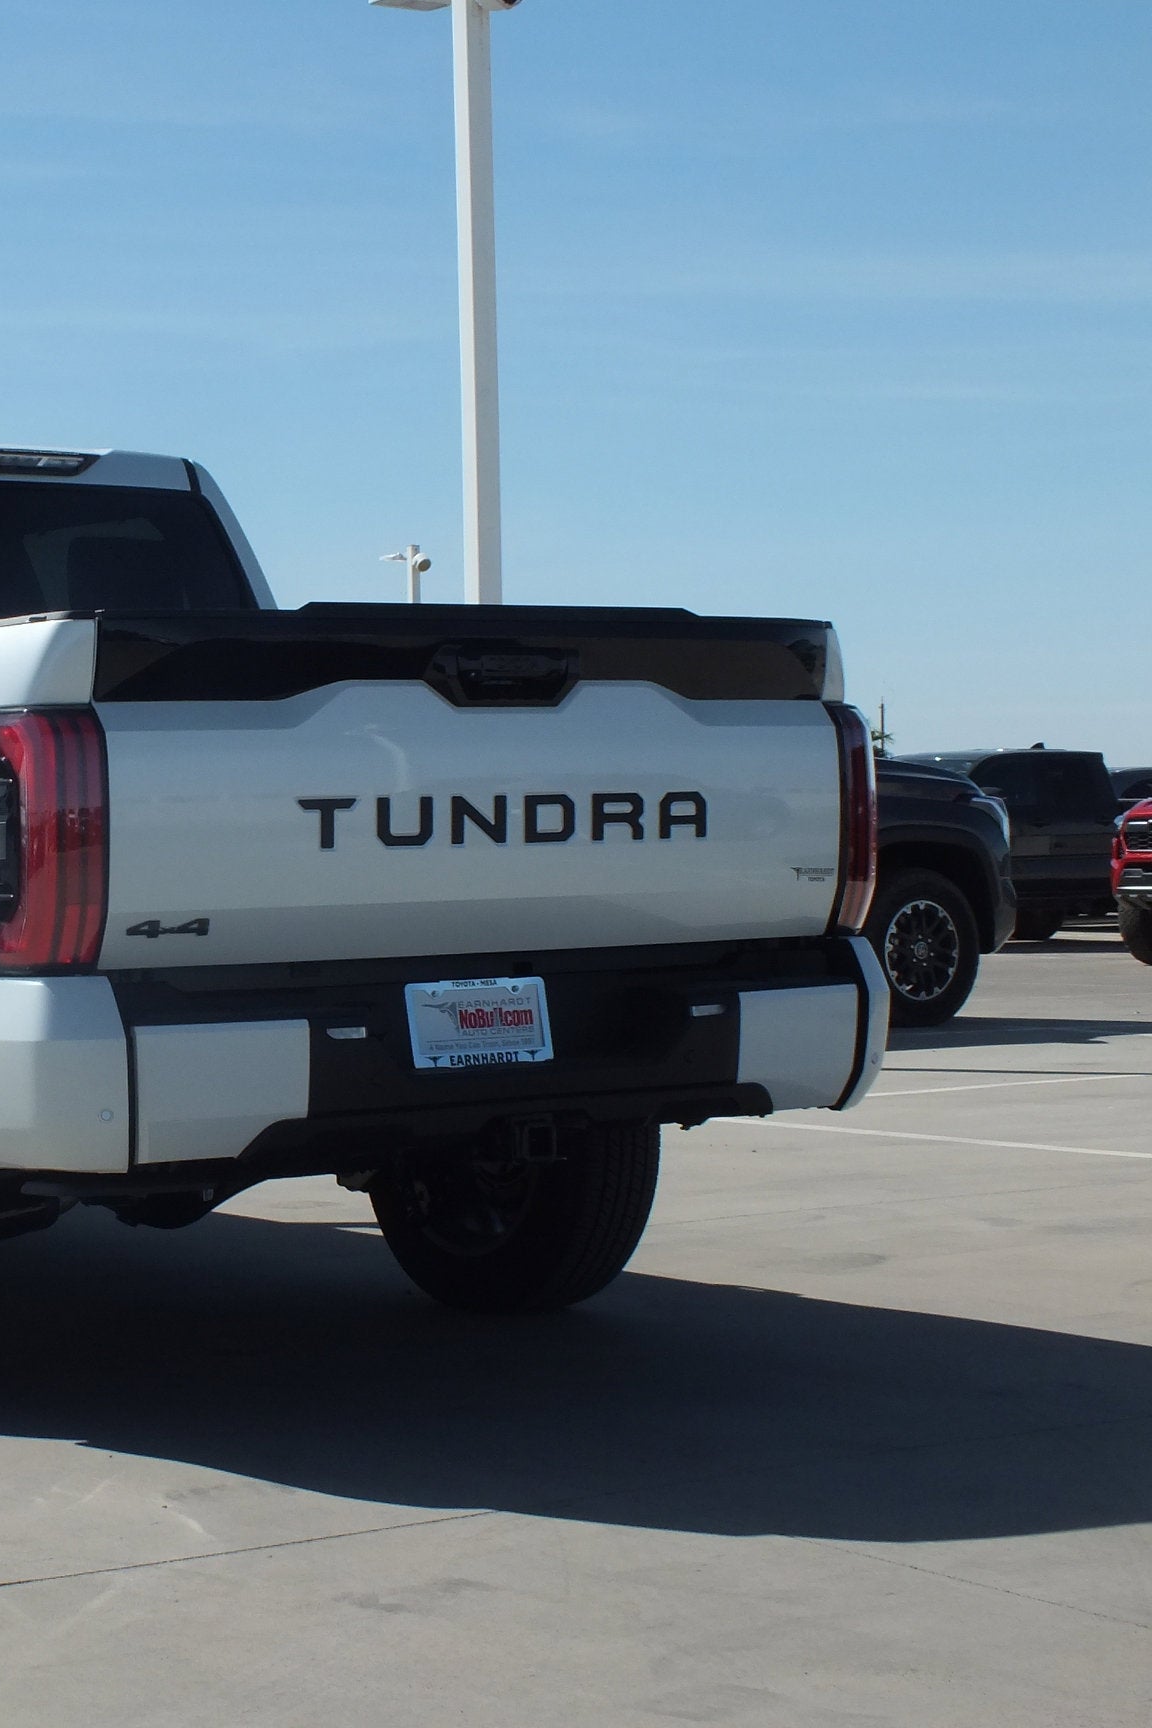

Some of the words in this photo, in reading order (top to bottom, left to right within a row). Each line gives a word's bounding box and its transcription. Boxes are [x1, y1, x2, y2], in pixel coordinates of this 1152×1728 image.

[298, 791, 707, 850] TUNDRA
[458, 997, 531, 1008] EARNHARDT
[491, 1026, 534, 1035] CENTERS
[450, 1051, 519, 1067] EARNHARDT
